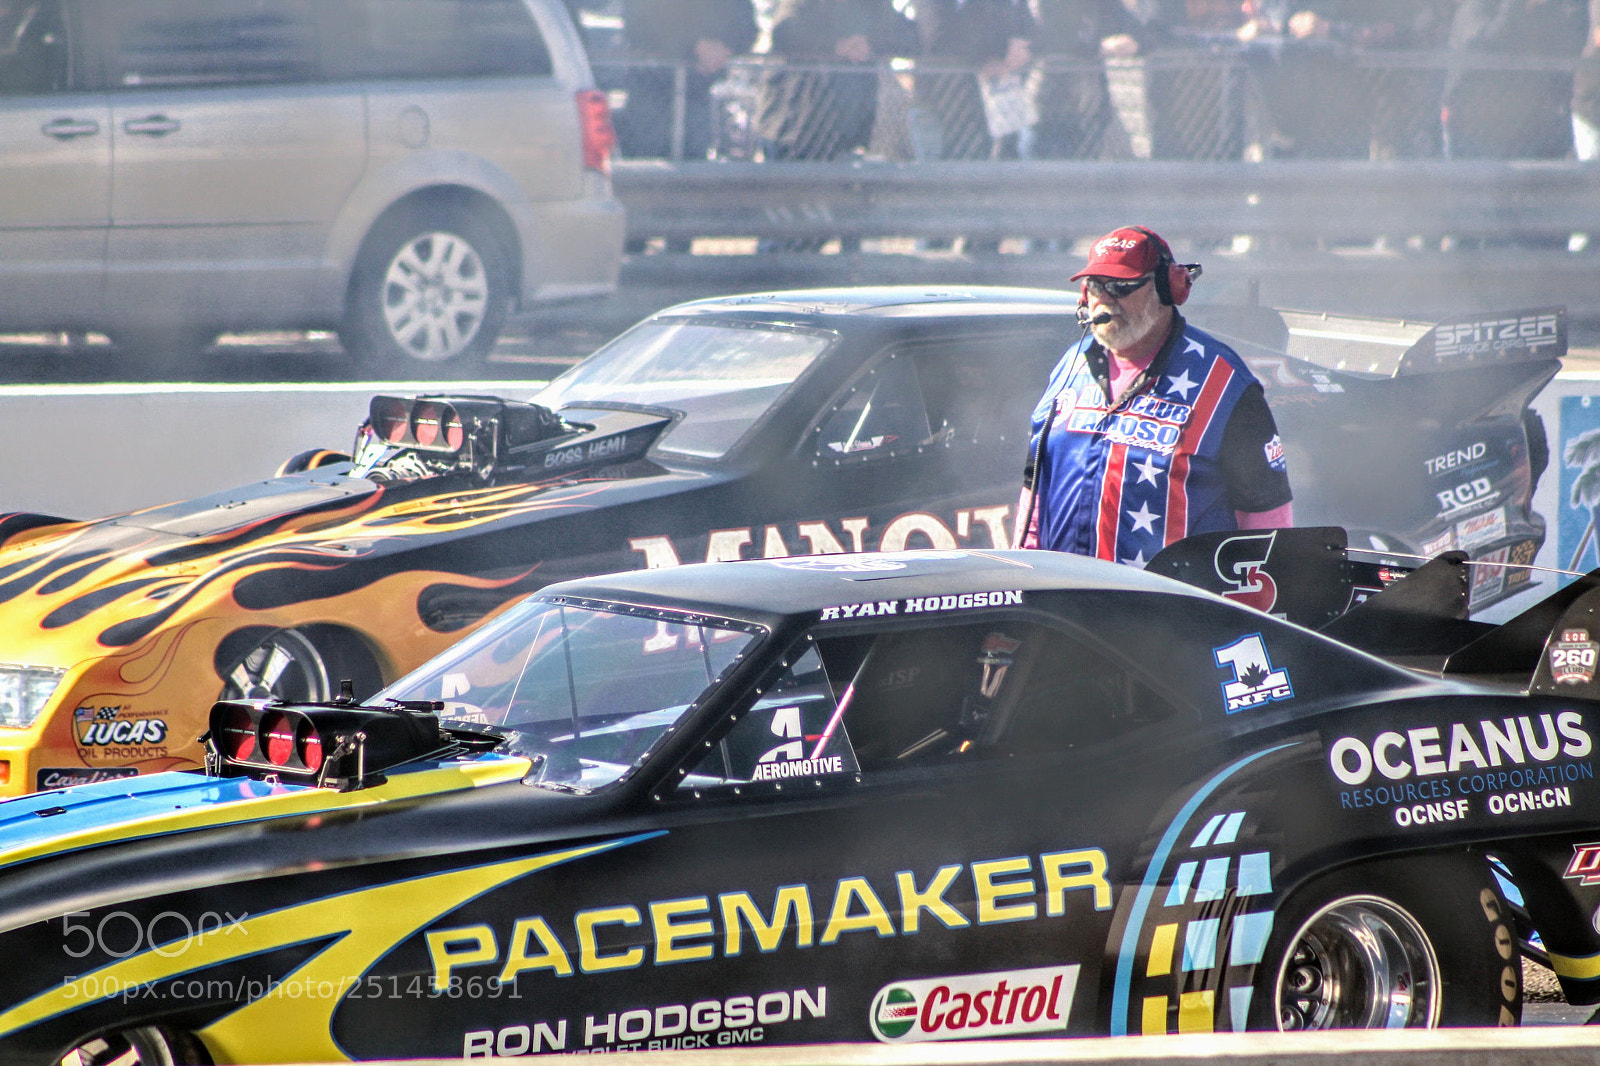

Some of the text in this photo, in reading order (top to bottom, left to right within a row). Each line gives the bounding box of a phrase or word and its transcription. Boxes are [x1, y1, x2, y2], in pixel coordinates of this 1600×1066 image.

[1435, 315, 1557, 345] SPITZER
[1131, 395, 1191, 424] CLUB
[544, 435, 626, 468] BOSS HEMI
[1424, 442, 1486, 475] TREND
[1436, 477, 1492, 510] RCD
[820, 589, 1023, 621] RYAN HODGSON
[1552, 649, 1596, 668] 260
[1228, 685, 1291, 711] NFC
[80, 719, 168, 746] LUCAS
[1329, 711, 1593, 786] OCEANUS
[80, 746, 168, 759] OIL PRODUCTS
[752, 756, 843, 781] AEROMOTIVE
[1340, 762, 1594, 809] RESOURCES CORPORATION
[1395, 786, 1571, 827] OCNSF OCN:CN
[424, 847, 1114, 992] PACEMAKER
[920, 974, 1063, 1033] Castrol
[463, 986, 827, 1059] RON HODGSON
[648, 1034, 711, 1052] BUICK
[717, 1027, 764, 1046] GMC
